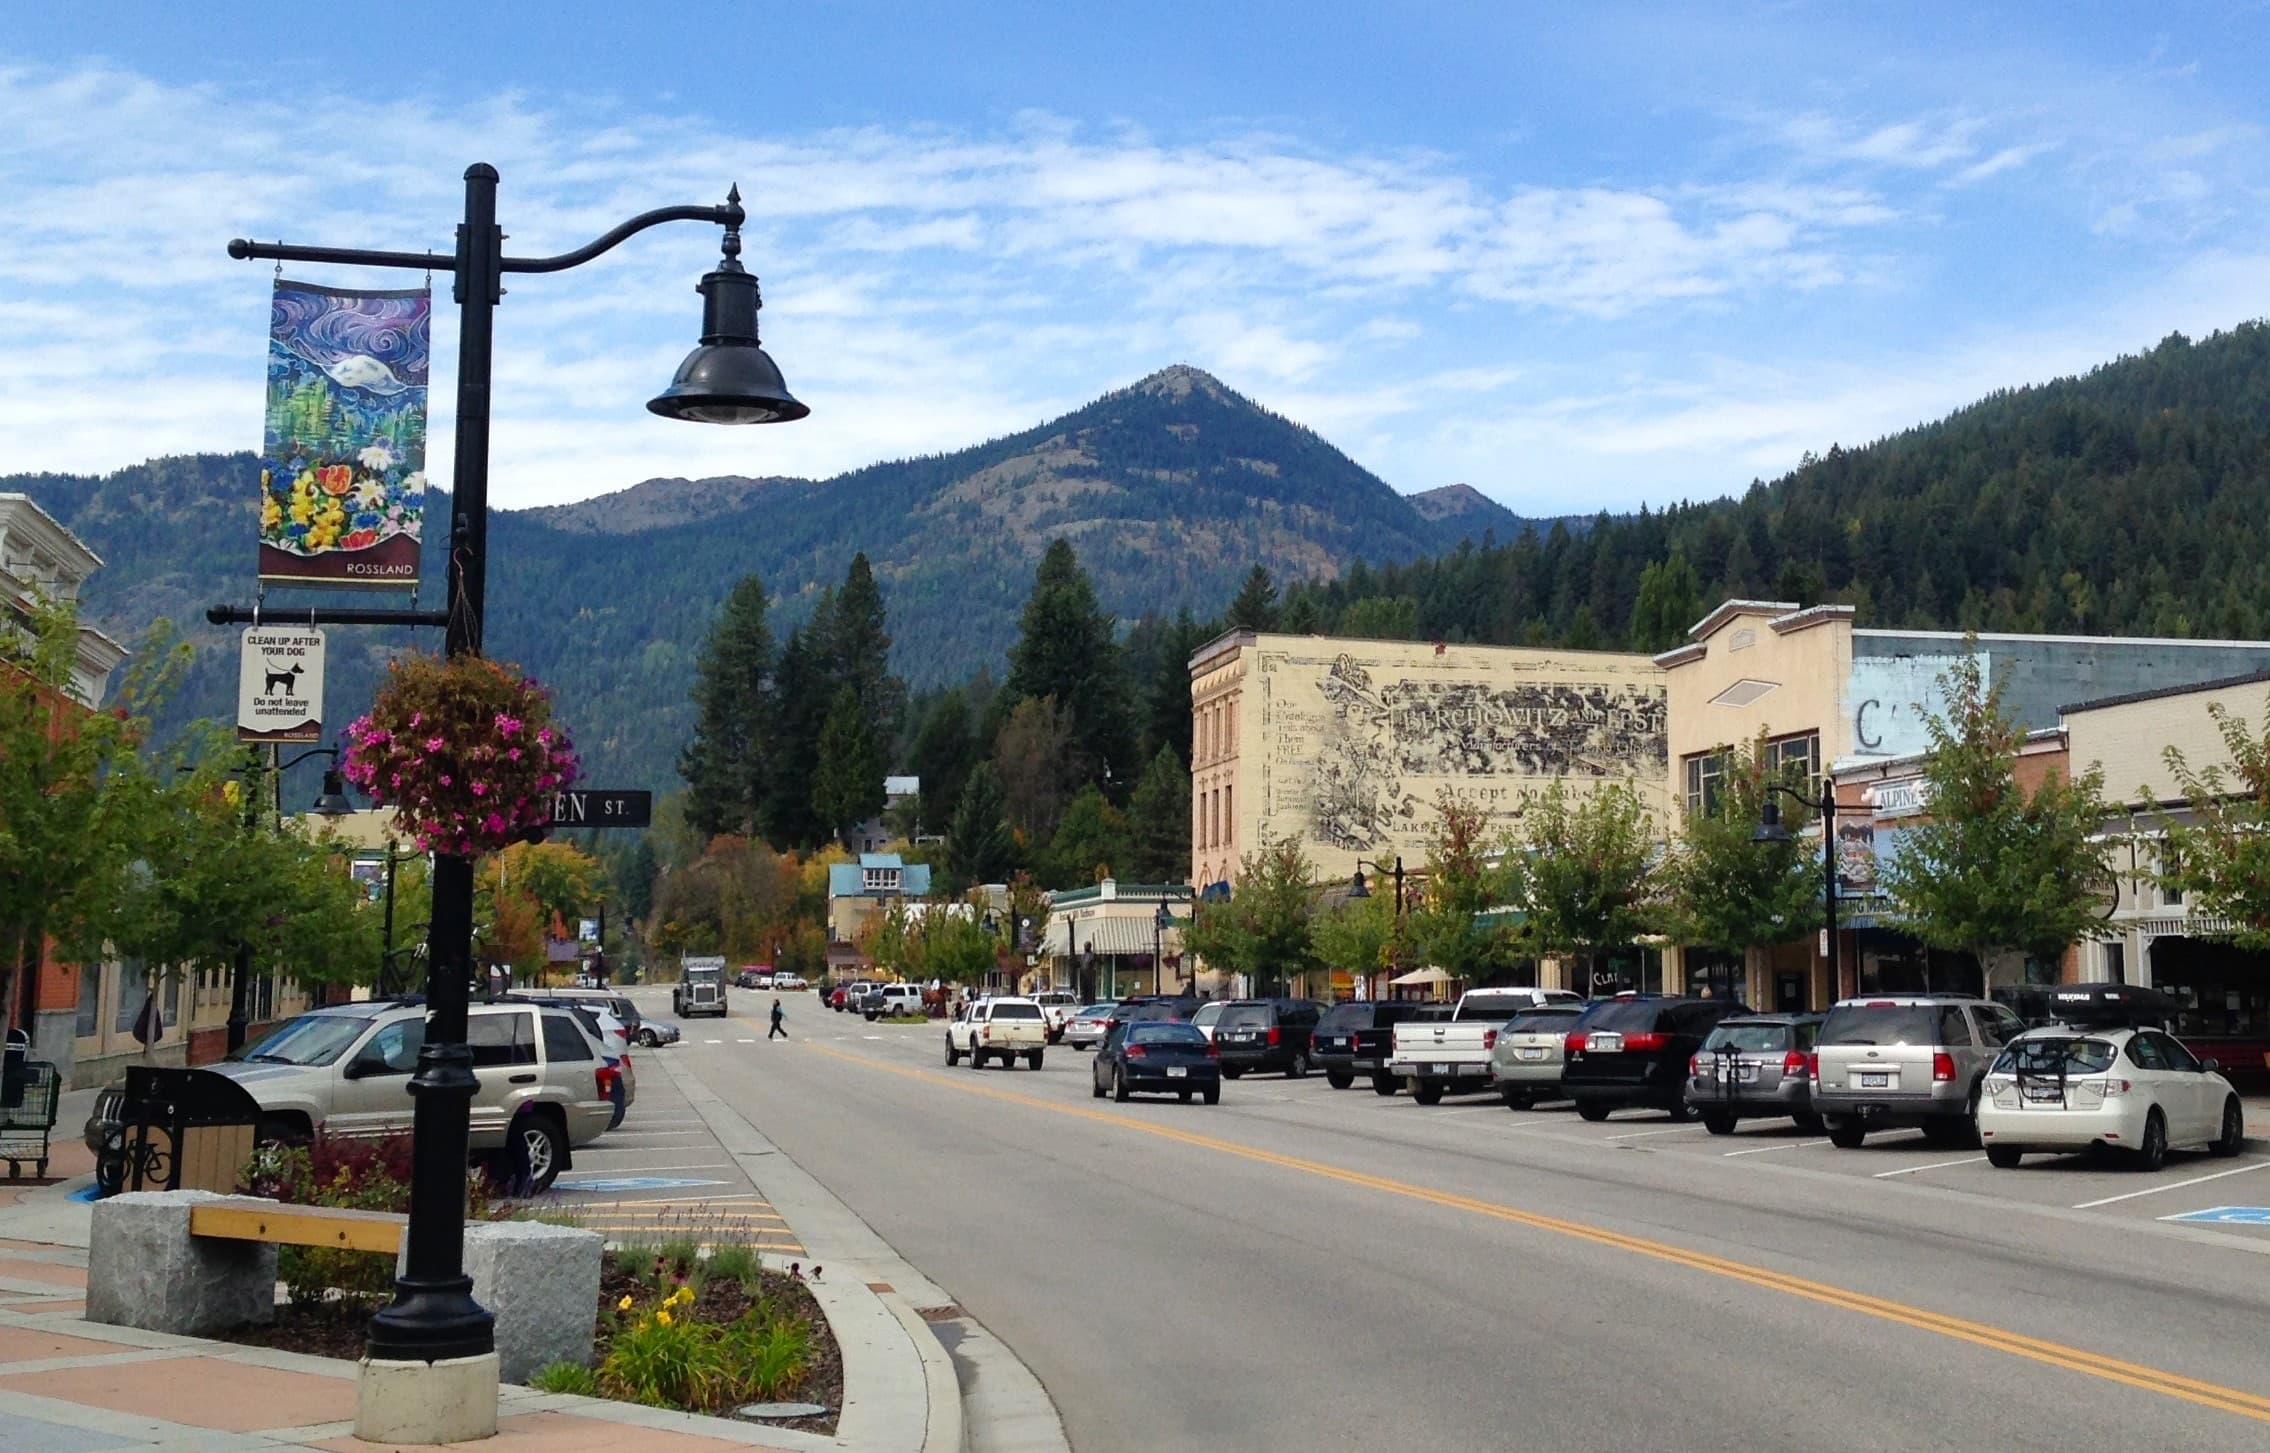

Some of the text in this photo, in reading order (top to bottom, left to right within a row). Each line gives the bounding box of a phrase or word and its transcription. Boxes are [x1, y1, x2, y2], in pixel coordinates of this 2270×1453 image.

[347, 563, 413, 575] ROSSLAND
[247, 636, 320, 647] CLEAN UP AFTER
[261, 647, 305, 656] YOUR DOG
[253, 697, 309, 707] Do not leave
[255, 706, 306, 716] unattended
[1443, 783, 1508, 804] Accept
[1515, 783, 1538, 800] No
[1881, 789, 1918, 809] ALPINE
[545, 792, 630, 822] EN ST.
